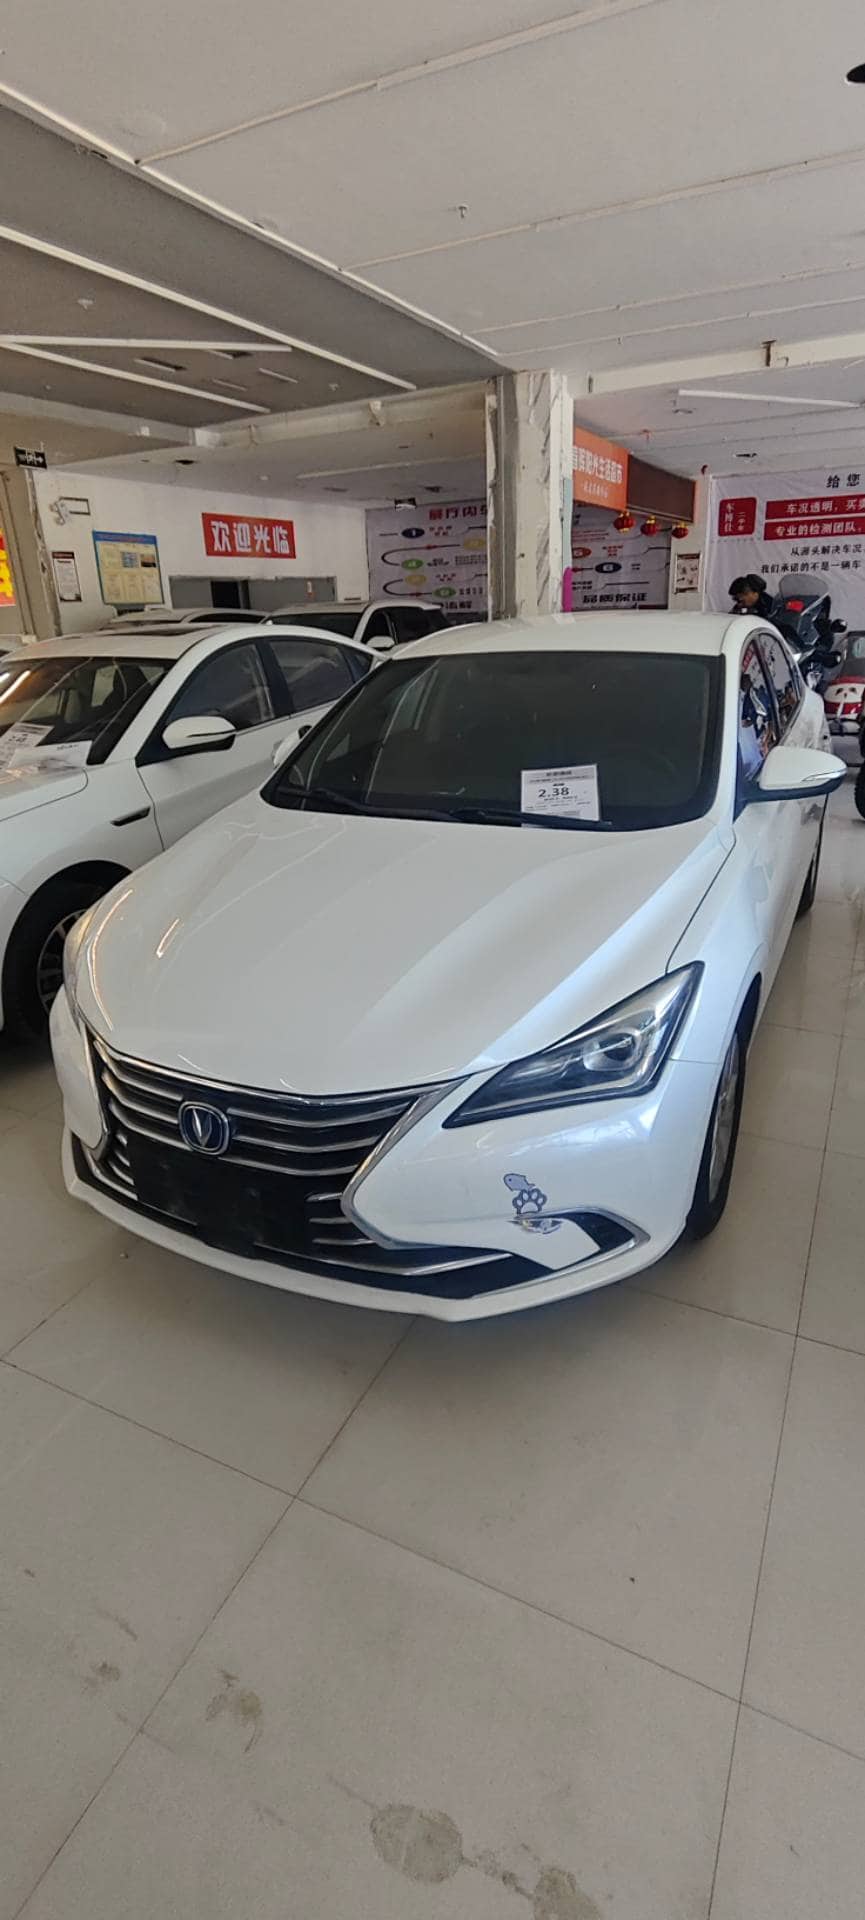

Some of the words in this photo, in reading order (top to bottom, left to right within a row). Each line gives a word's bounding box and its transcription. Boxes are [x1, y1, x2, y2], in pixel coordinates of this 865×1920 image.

[826, 473, 860, 489] 给您
[210, 520, 290, 554] 欢迎光临
[761, 559, 862, 573] 我们承诺的不是一辆车
[538, 787, 570, 798] 2.38
